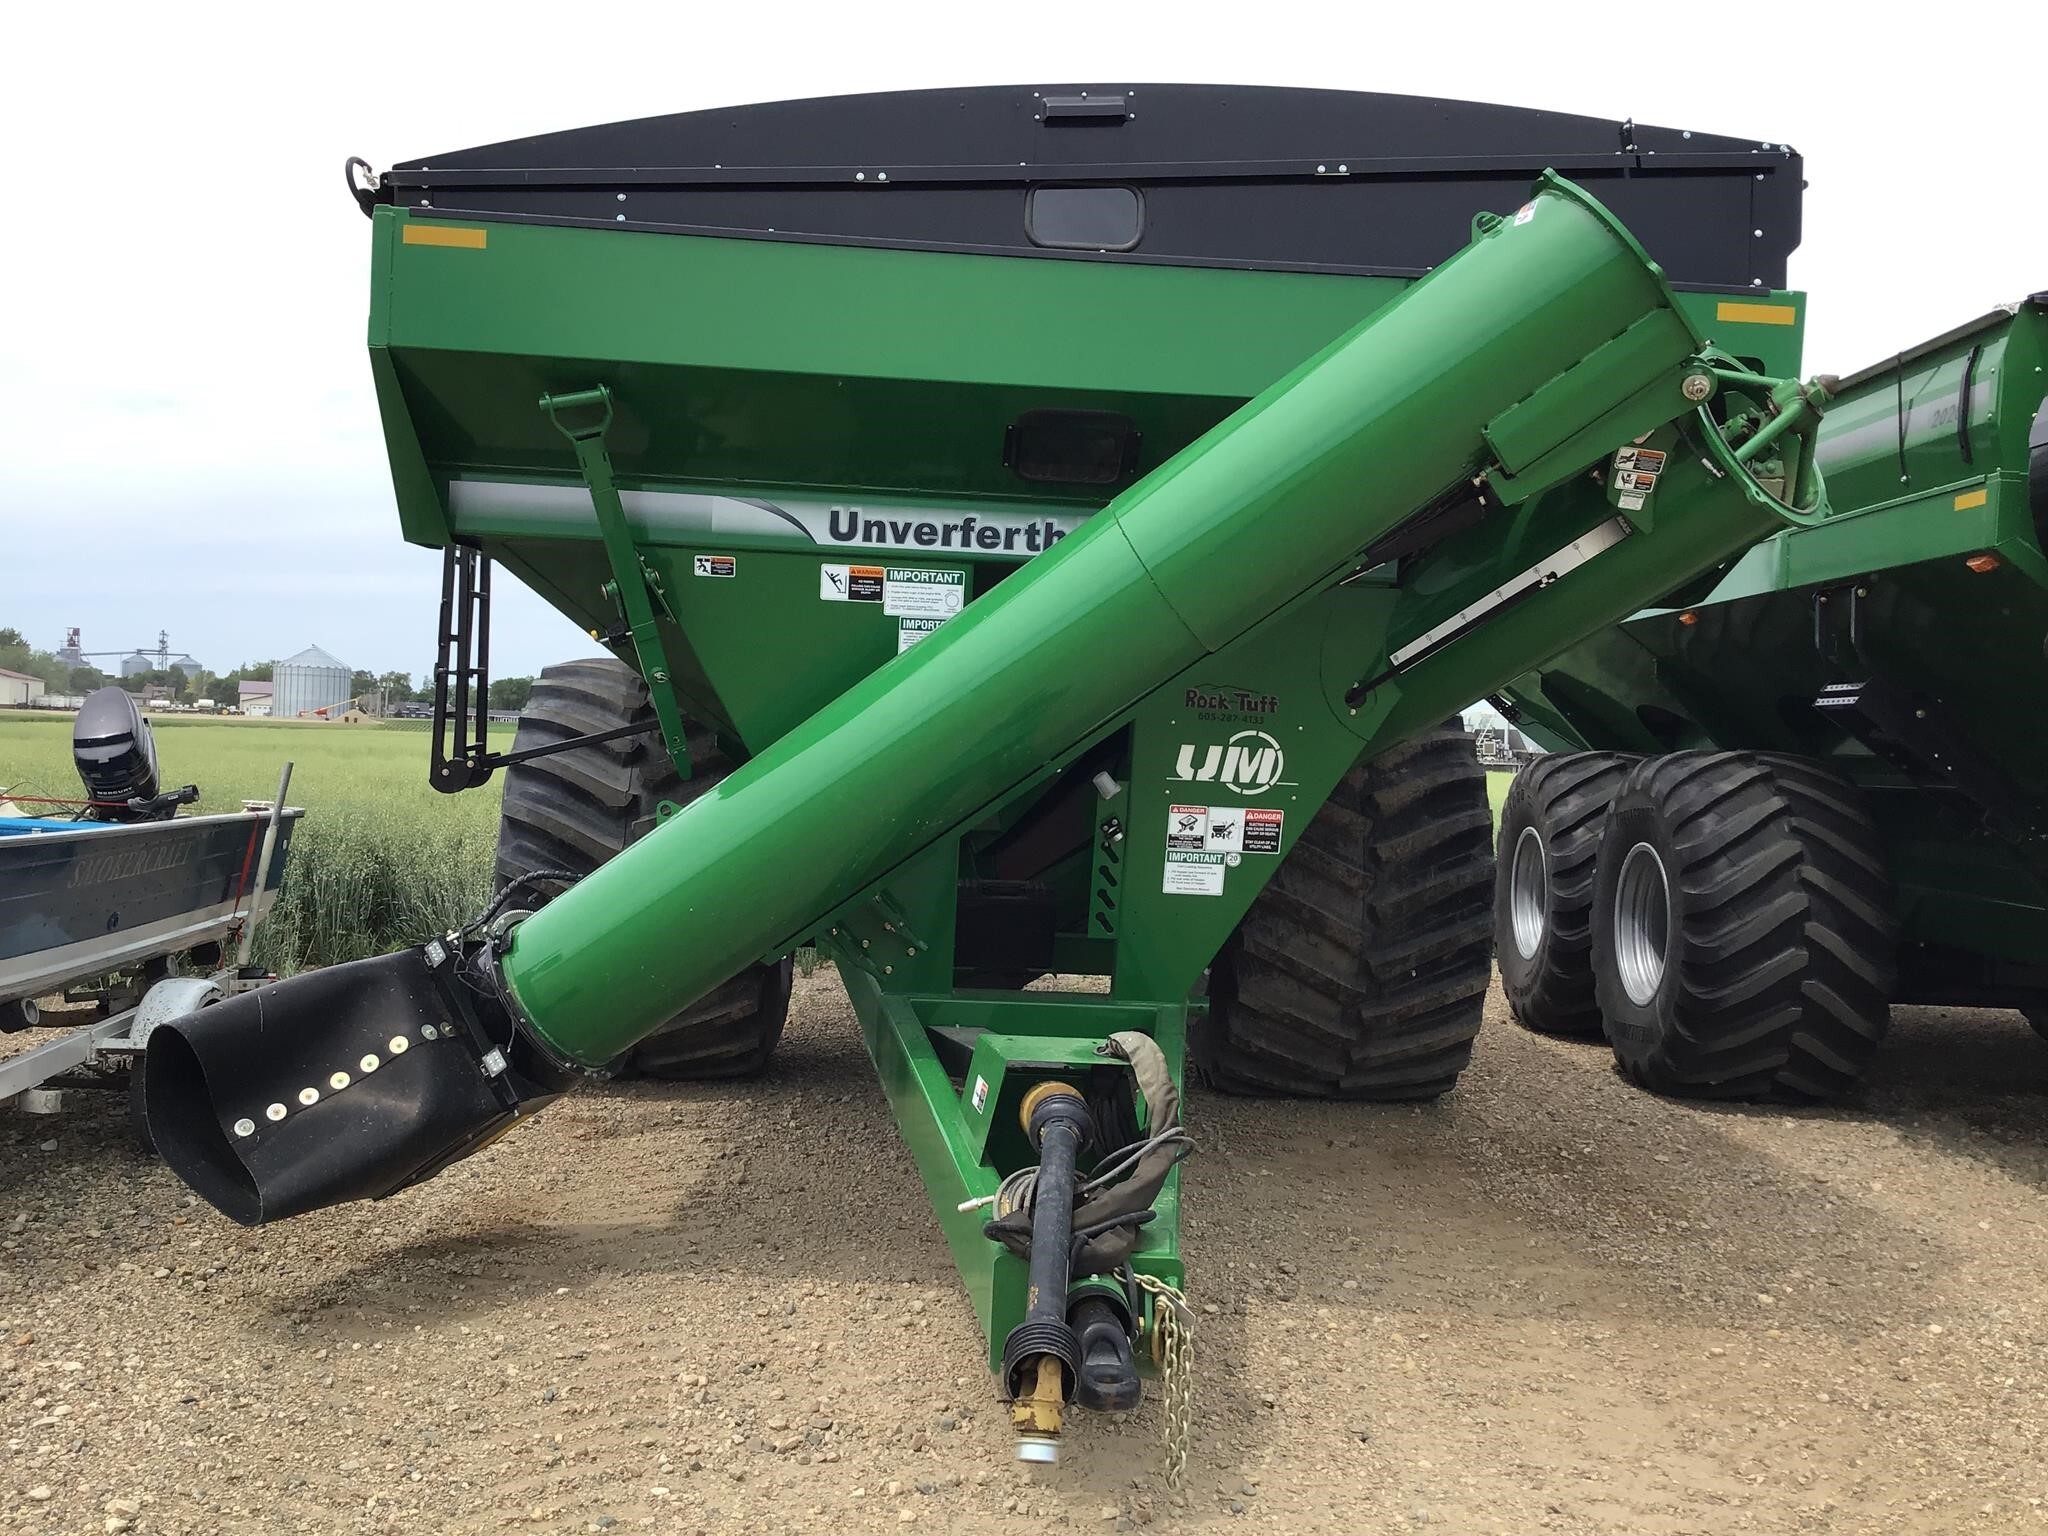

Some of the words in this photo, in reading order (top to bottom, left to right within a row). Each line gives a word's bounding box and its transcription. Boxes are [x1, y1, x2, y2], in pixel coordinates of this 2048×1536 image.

[829, 510, 1067, 552] Unverferth
[889, 569, 961, 584] IMPORTANT
[902, 618, 945, 631] IMPORT
[96, 786, 133, 795] MERCURY
[1253, 813, 1281, 821] DANGER
[1168, 852, 1223, 864] IMPORTANT
